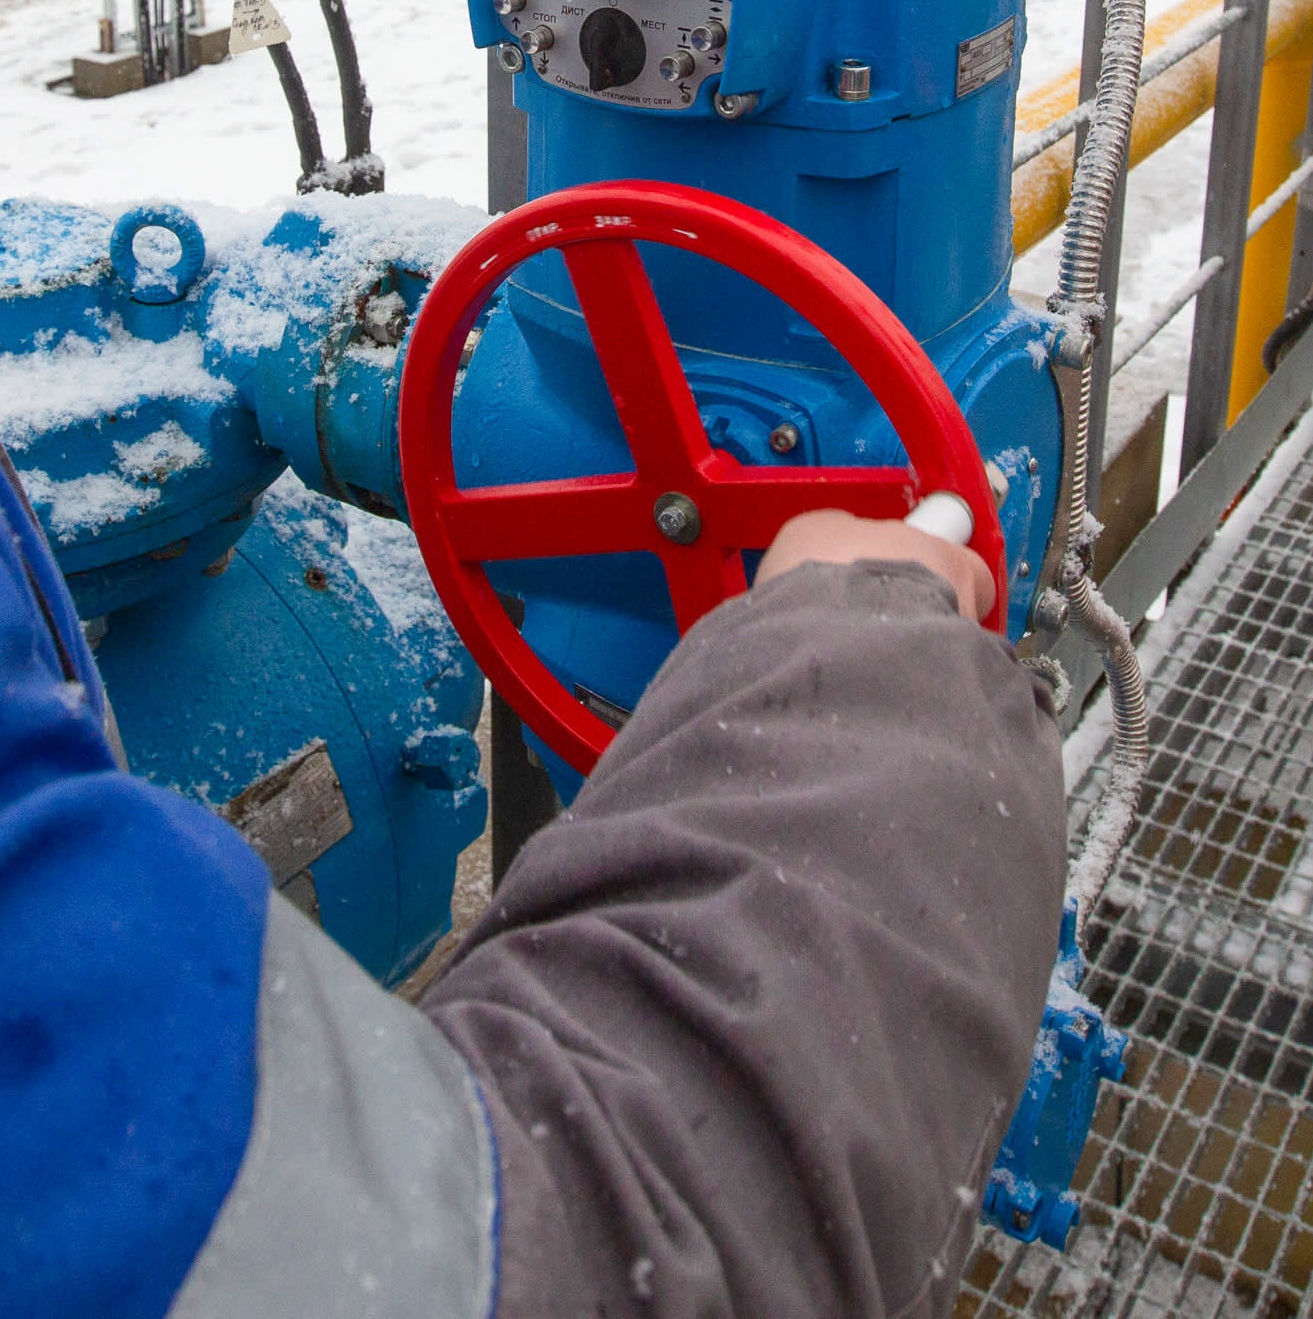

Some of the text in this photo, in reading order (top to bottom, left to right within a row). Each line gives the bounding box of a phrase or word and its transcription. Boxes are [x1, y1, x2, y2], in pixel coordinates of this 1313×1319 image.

[560, 5, 585, 17] ДИСТ
[532, 12, 557, 24] СТОП
[640, 19, 667, 32] МЕСТ
[642, 97, 652, 105] от
